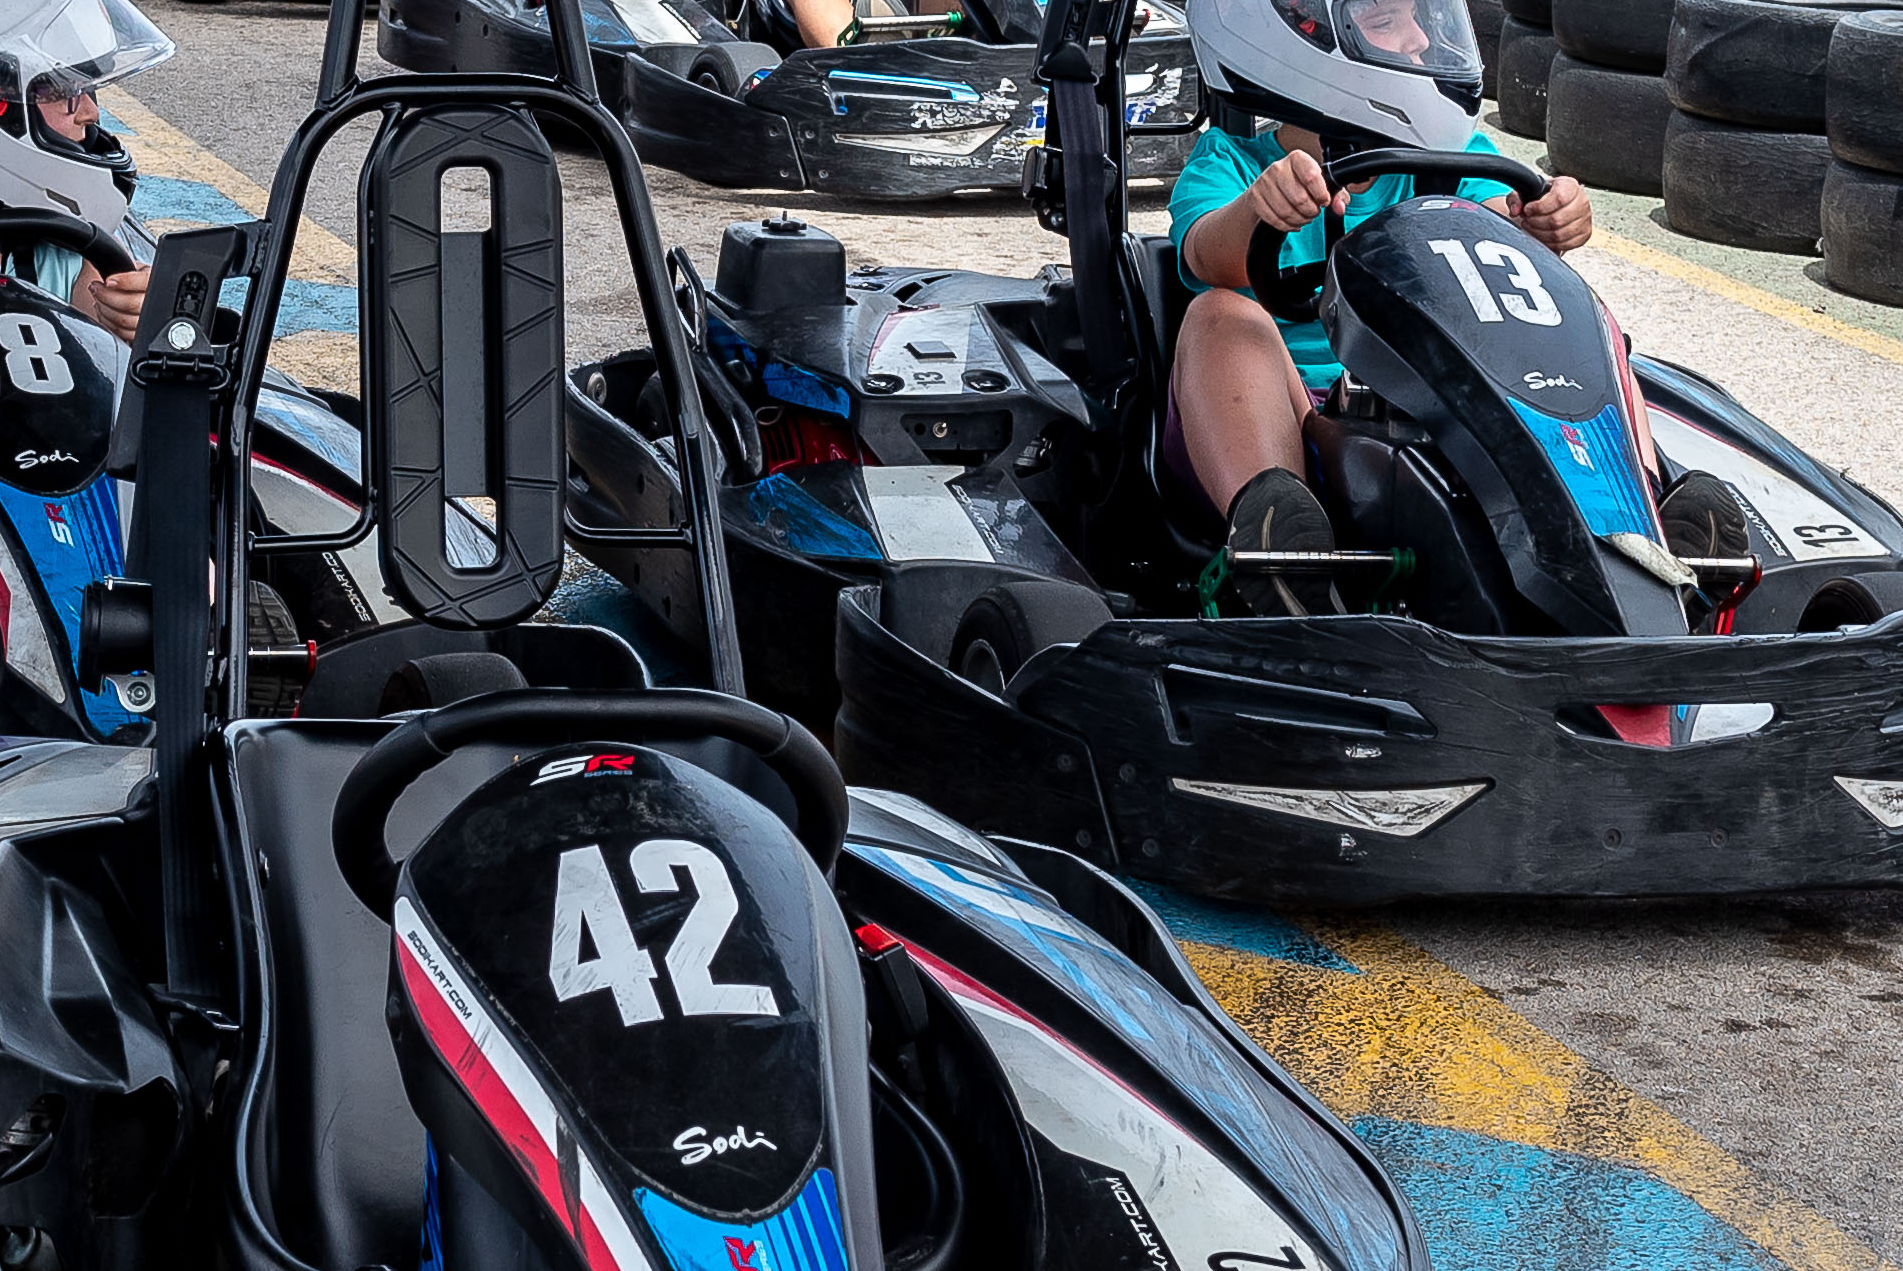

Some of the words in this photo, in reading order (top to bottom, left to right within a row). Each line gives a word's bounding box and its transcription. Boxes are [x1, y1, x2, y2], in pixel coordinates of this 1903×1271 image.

[1427, 238, 1563, 327] 13
[912, 371, 946, 386] 13
[14, 450, 80, 470] Sodi
[1793, 524, 1859, 548] 13
[529, 754, 634, 786] SR
[547, 838, 781, 1028] 42
[672, 1125, 778, 1166] Sodi
